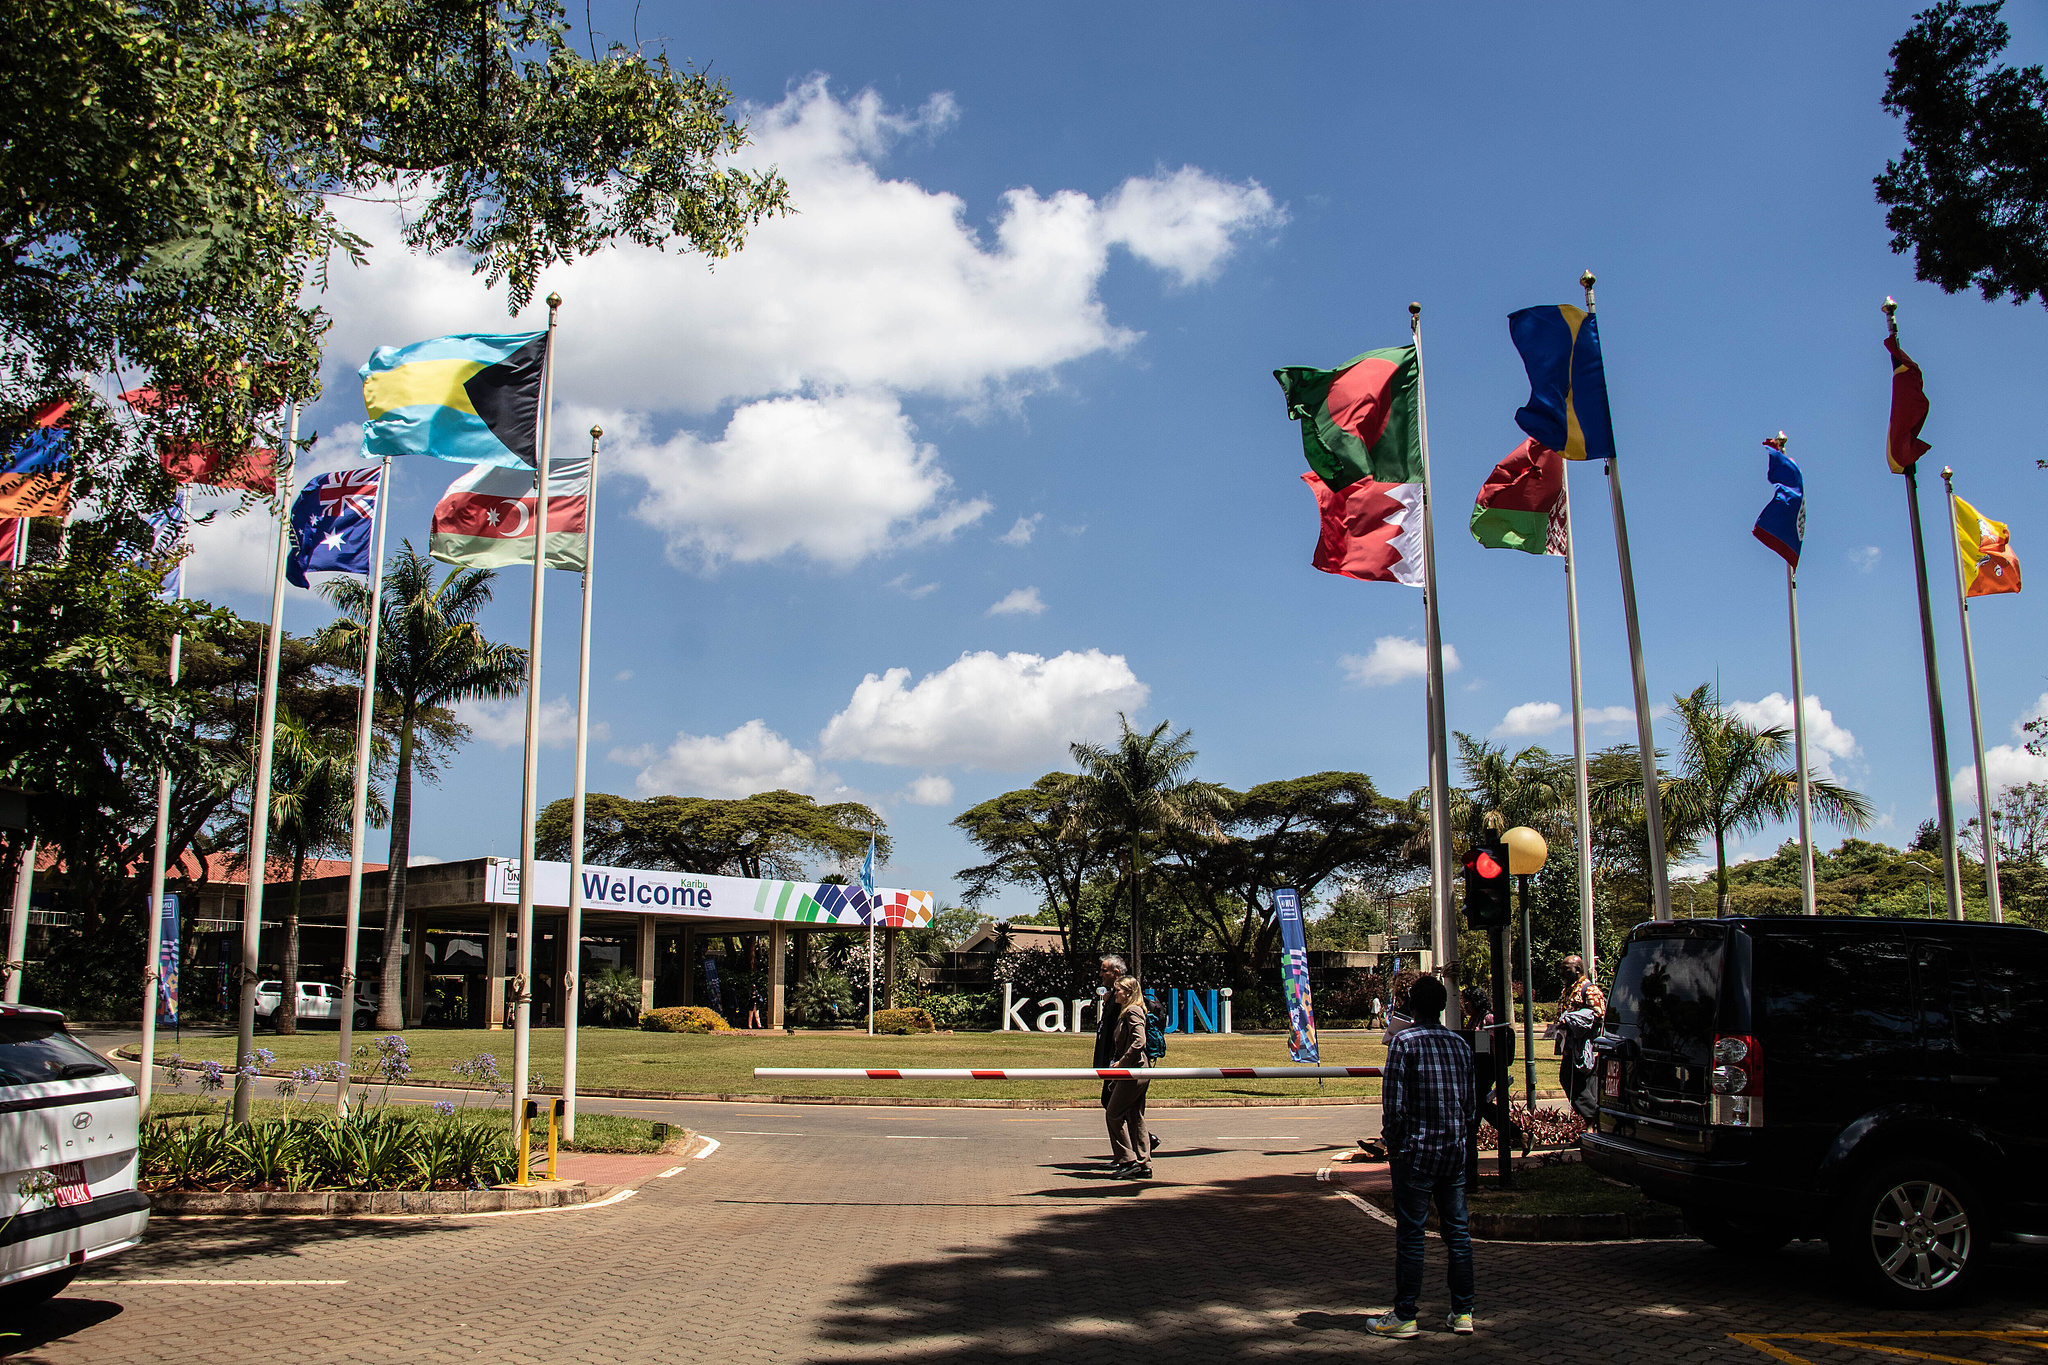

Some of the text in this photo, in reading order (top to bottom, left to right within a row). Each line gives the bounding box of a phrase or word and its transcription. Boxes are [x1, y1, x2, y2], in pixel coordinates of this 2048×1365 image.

[582, 872, 712, 908] Welcome
[680, 878, 708, 889] Karibu
[1002, 982, 1232, 1033] kariUNi
[40, 1133, 114, 1152] KONA
[58, 1183, 89, 1205] 102AK
